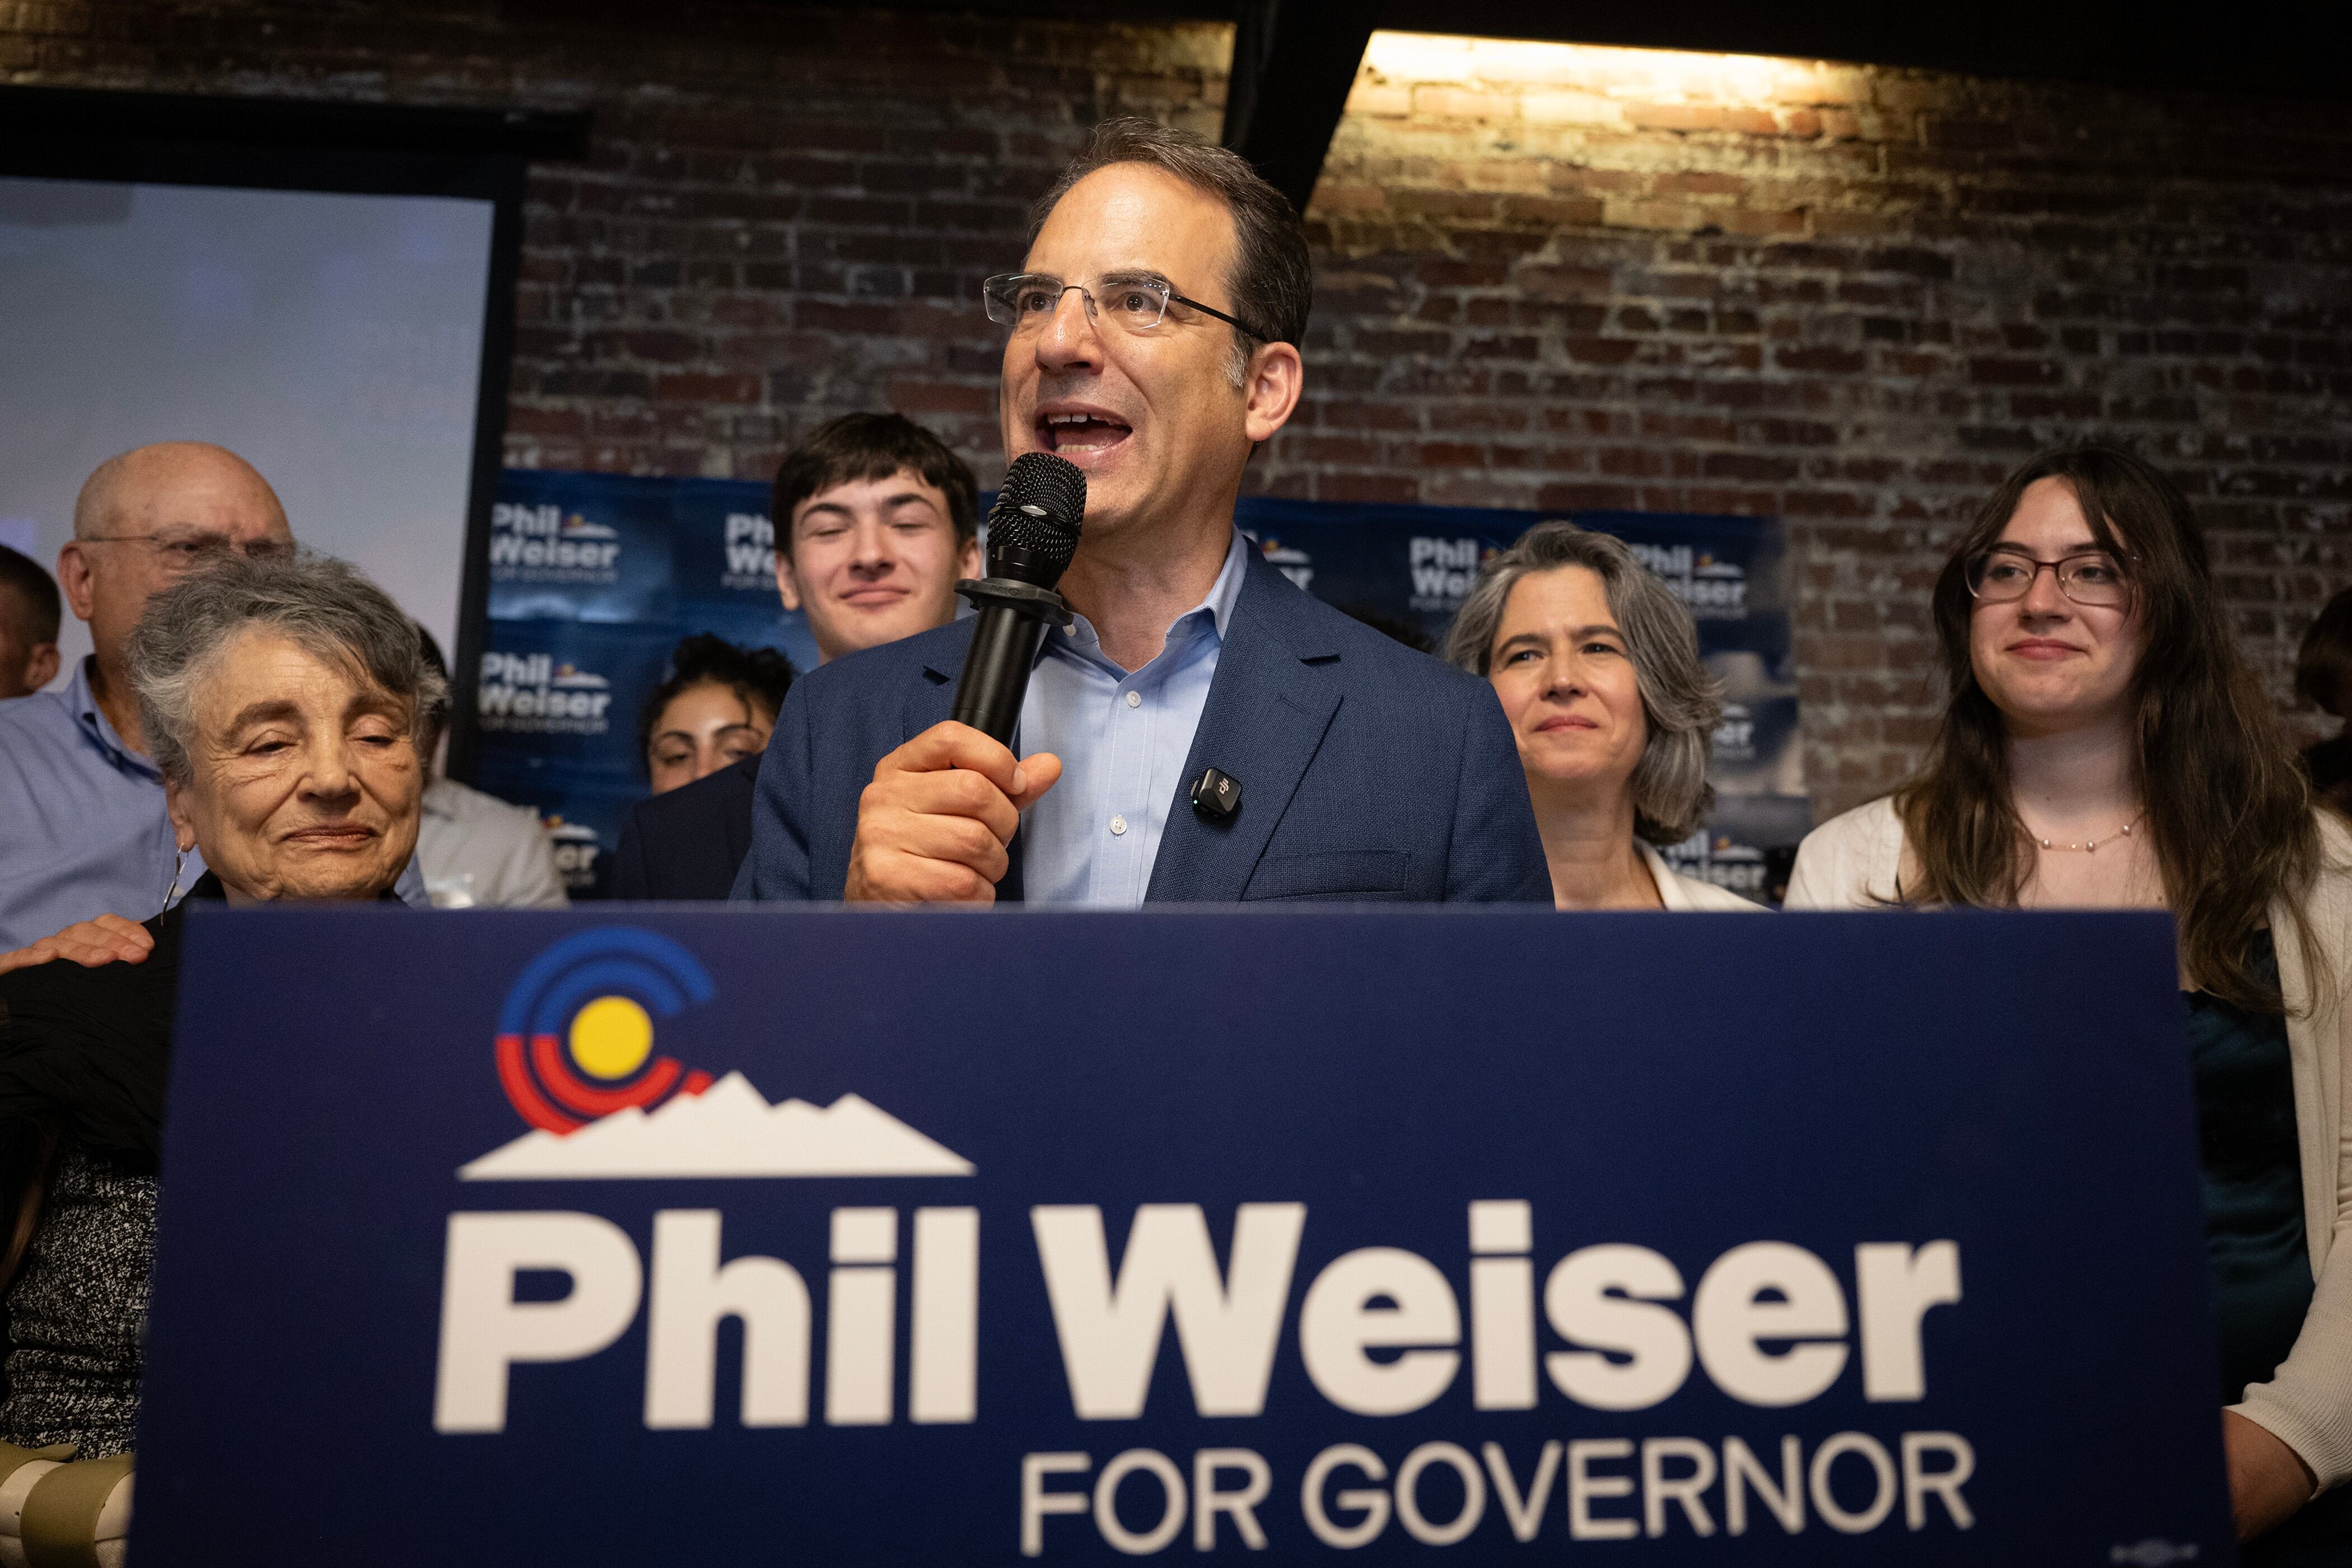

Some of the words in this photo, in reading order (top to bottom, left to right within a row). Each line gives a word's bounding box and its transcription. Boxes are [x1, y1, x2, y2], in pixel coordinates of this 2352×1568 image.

[492, 503, 560, 534] Phil
[726, 513, 774, 544] Ph
[489, 534, 619, 567] Weiser
[1409, 536, 1478, 568] Phil
[480, 652, 552, 684] Phil
[478, 684, 611, 717] Weiser
[433, 1206, 981, 1434] Phil
[1029, 1199, 1962, 1421] Weiser
[1020, 1448, 1272, 1556] FOR
[1300, 1431, 1975, 1550] GOVERNOR
